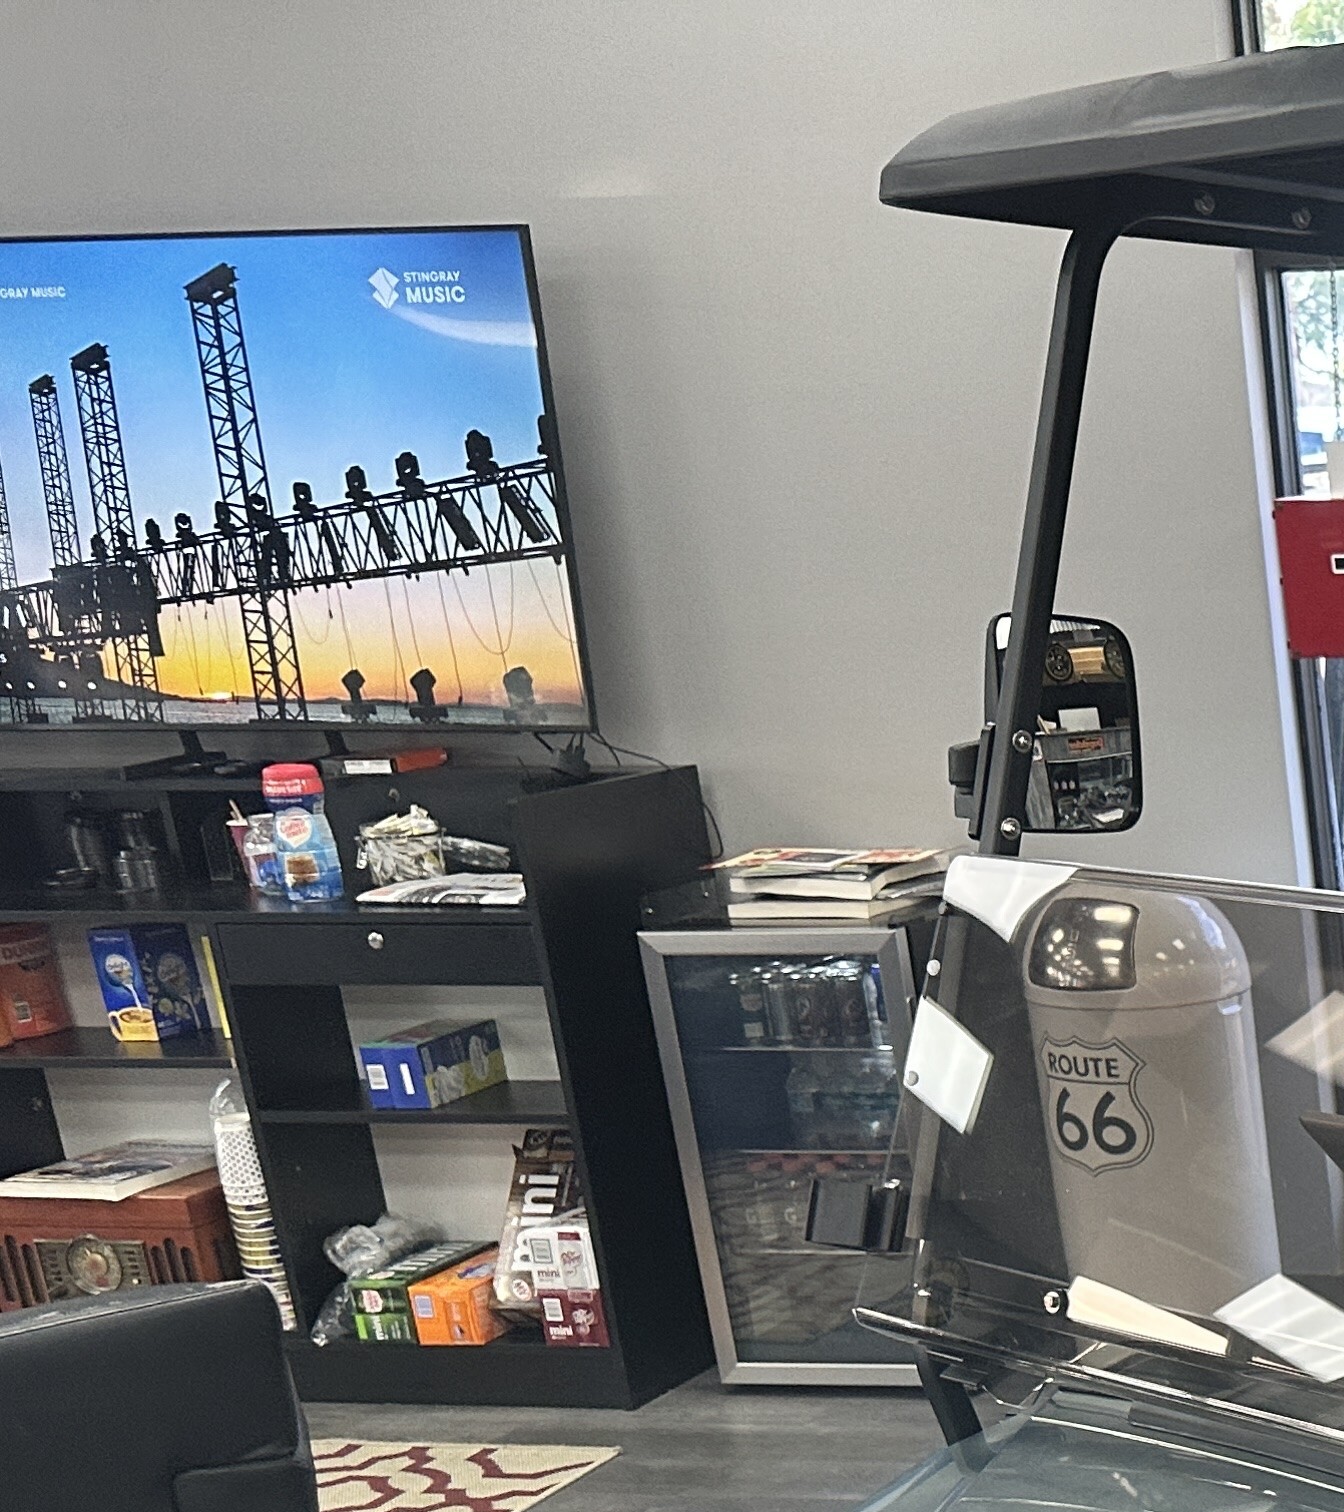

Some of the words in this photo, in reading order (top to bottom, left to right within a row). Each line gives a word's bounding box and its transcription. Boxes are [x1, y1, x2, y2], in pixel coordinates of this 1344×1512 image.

[403, 270, 461, 283] STINGRAY
[31, 285, 67, 298] MUSIC
[405, 285, 466, 304] MUSIC
[1047, 1051, 1121, 1079] ROUTE
[1055, 1086, 1138, 1156] 66
